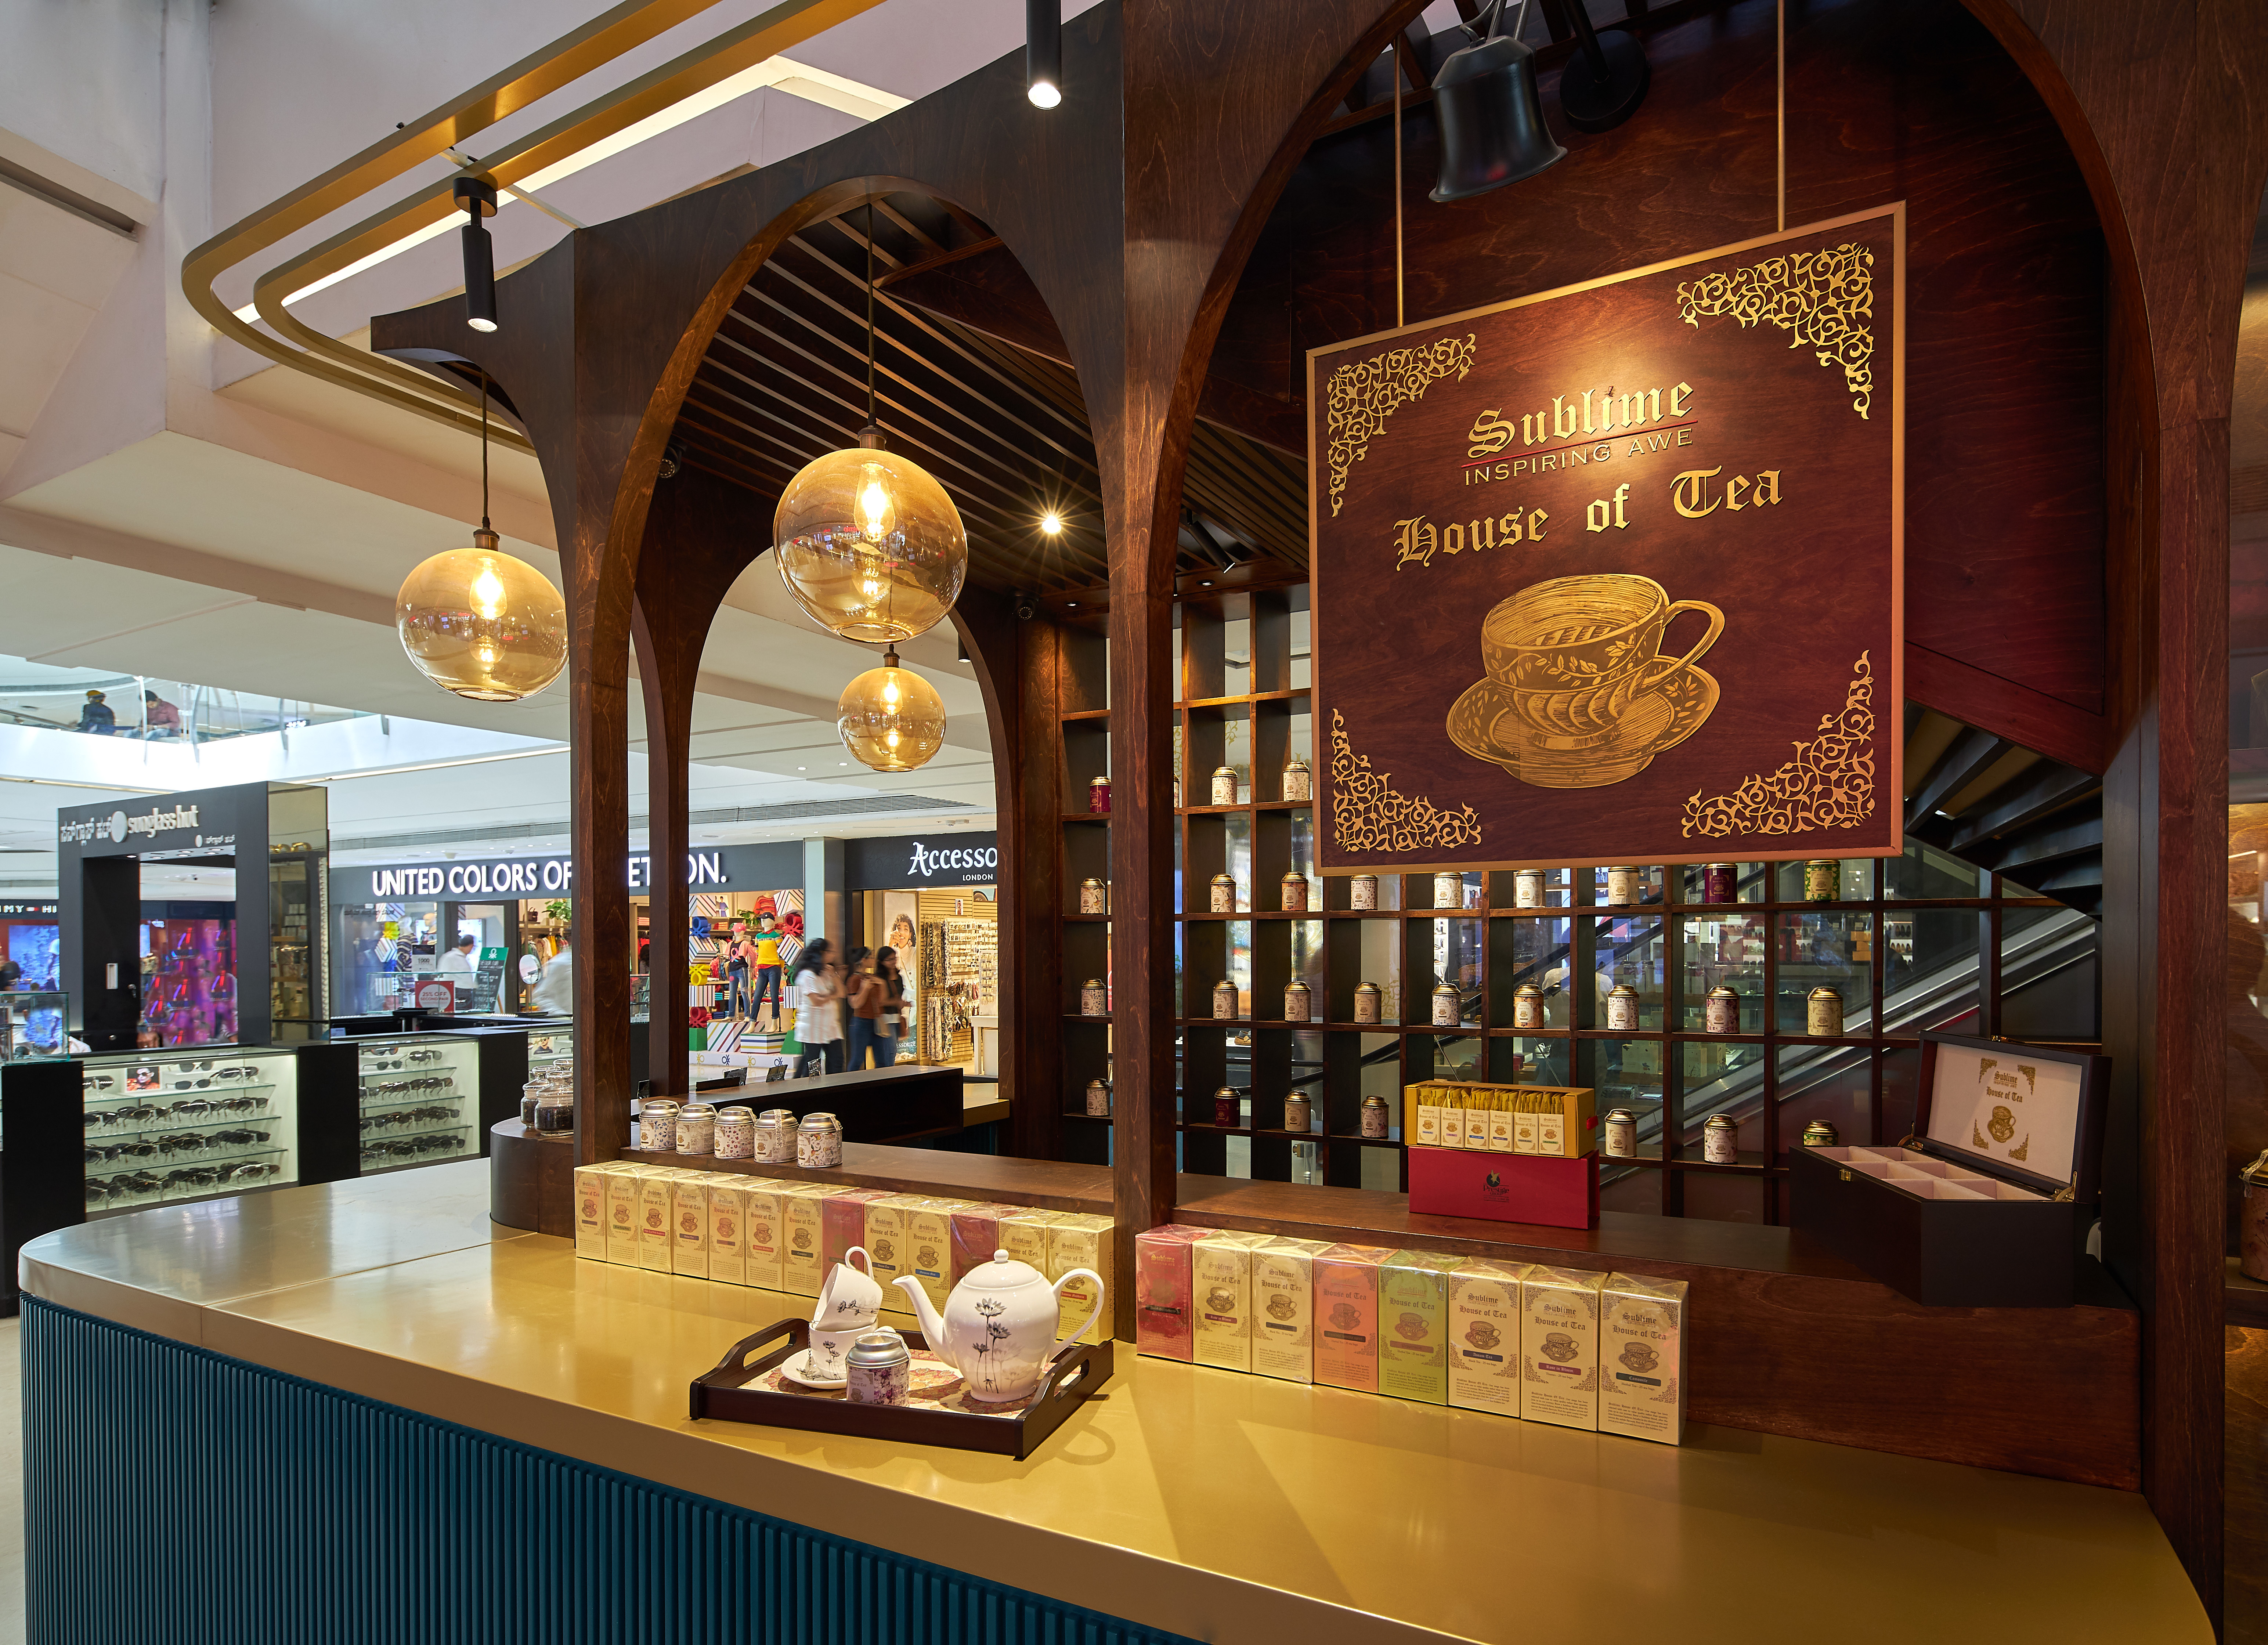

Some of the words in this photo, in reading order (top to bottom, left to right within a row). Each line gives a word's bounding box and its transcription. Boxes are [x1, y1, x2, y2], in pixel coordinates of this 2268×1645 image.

[1467, 381, 1694, 459] Sublime
[1465, 444, 1611, 485] INSPIRING
[1628, 428, 1693, 456] AWE
[1393, 506, 1549, 571] House
[1586, 483, 1630, 534] of
[1669, 466, 1783, 519] Tea
[373, 870, 444, 896] UNITED
[448, 863, 537, 893] COLORS
[543, 861, 571, 890] OF
[1994, 1071, 2017, 1083] Sublime
[1986, 1087, 2003, 1098] House
[2005, 1091, 2010, 1099] of
[2012, 1092, 2022, 1102] Tea
[1484, 1185, 1509, 1194] Prestige
[918, 1223, 937, 1232] Sublime
[1011, 1236, 1032, 1245] Sublime
[1005, 1246, 1021, 1254] House
[1061, 1242, 1083, 1251] Sublime
[1055, 1252, 1072, 1261] House
[1151, 1253, 1175, 1263] Sublime
[1208, 1261, 1233, 1271] Sublime
[1202, 1272, 1220, 1281] House
[1268, 1268, 1294, 1277] Sublime
[1261, 1280, 1281, 1288] House
[1323, 1288, 1344, 1297] House
[1354, 1292, 1366, 1300] Tea
[1397, 1285, 1426, 1295] Sublime
[1389, 1297, 1411, 1306] House
[1421, 1301, 1434, 1309] Tea
[1467, 1293, 1498, 1304] Sublime
[1459, 1305, 1482, 1315] House
[1493, 1310, 1507, 1318] Tea
[1543, 1303, 1576, 1315] Sublime
[1535, 1316, 1559, 1326] House
[1570, 1321, 1585, 1330] Tea
[1622, 1312, 1657, 1324] Sublime
[1612, 1324, 1638, 1336] House
[1650, 1331, 1666, 1340] Tea
